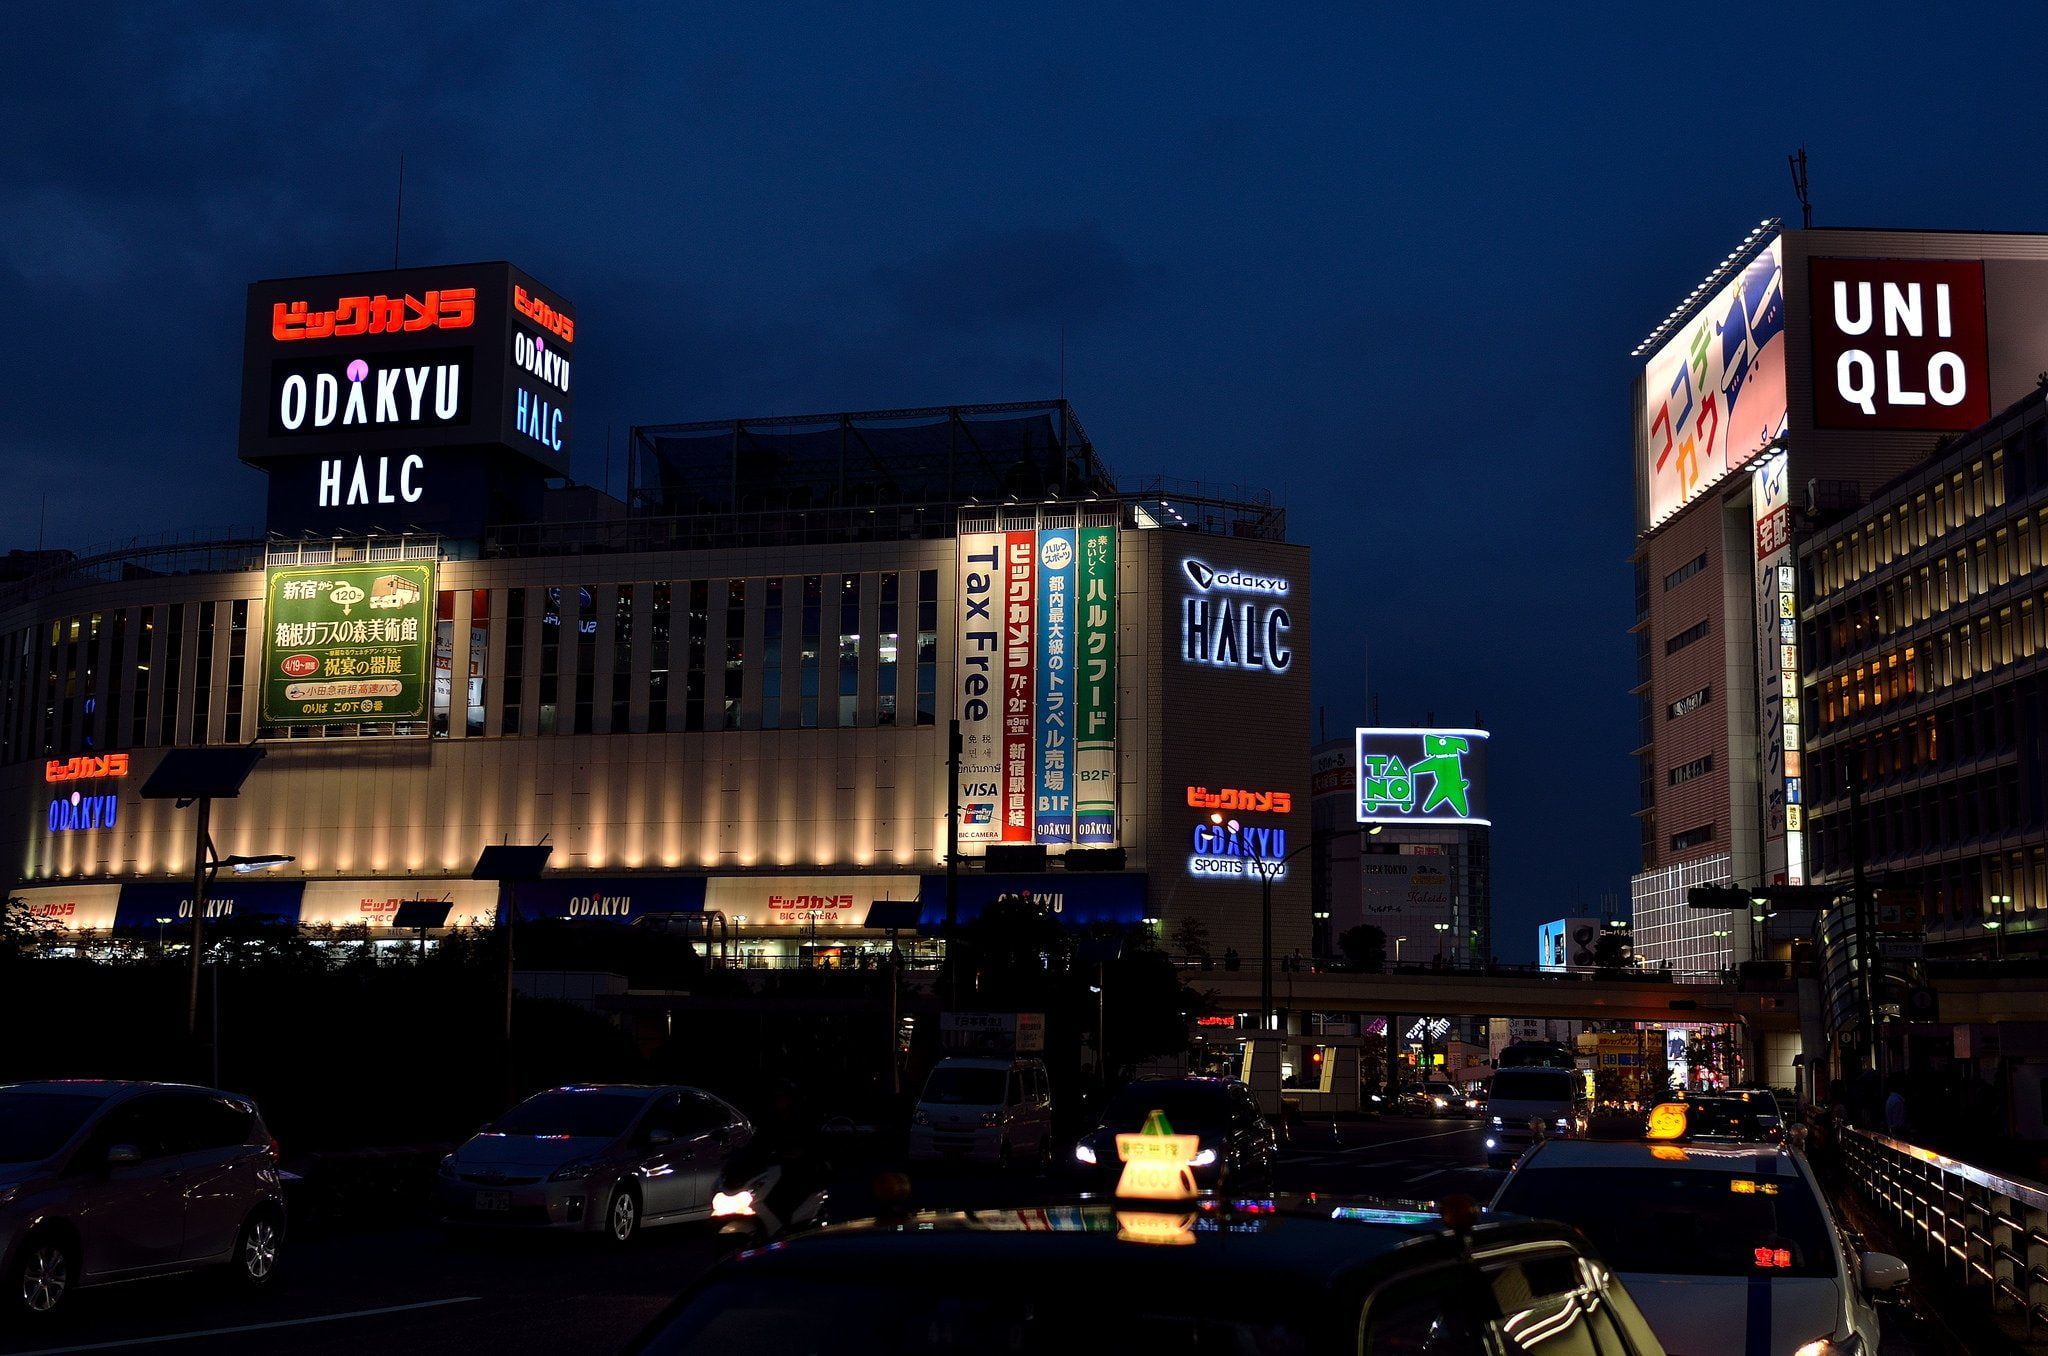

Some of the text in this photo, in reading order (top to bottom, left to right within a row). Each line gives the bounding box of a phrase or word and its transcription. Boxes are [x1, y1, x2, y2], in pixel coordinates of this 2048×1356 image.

[273, 288, 476, 341] ビックカメラ
[514, 285, 574, 343] ビックカメラ
[1833, 281, 1952, 337] UNI
[515, 332, 569, 392] ODAKYU
[281, 364, 459, 429] ODAKYU
[1837, 349, 1967, 415] QLO
[517, 387, 562, 451] HALC
[319, 455, 423, 506] HALC
[1760, 510, 1787, 552] 宅配
[1044, 551, 1071, 565] スポーツ
[1045, 542, 1068, 555] ハルク
[1086, 538, 1097, 576] おいしく
[1097, 535, 1109, 564] 楽しく
[283, 580, 333, 600] 新宿から
[1218, 573, 1288, 591] odakyu
[275, 617, 418, 647] 箱根ガラスの森美術館
[965, 545, 999, 721] Tax Free
[1008, 543, 1031, 713] ビックカメラ 7F 2F
[1187, 599, 1291, 670] HALC
[324, 655, 402, 677] 祝宴の器展
[1086, 579, 1108, 734] ハルクフード
[1762, 565, 1781, 775] クリーニング
[306, 683, 399, 697] 小田急箱根高速バス
[1038, 575, 1069, 811] 都内最大級のトラベル売場 B1F
[302, 703, 328, 714] のりば
[45, 753, 129, 782] ビックカメラ
[1080, 770, 1111, 782] B2F
[1365, 755, 1408, 777] TA
[961, 783, 998, 796] VISA
[1008, 742, 1026, 828] 新宿駅直結
[1187, 786, 1291, 813] ビックカメラ
[1365, 777, 1410, 800] NO
[49, 795, 117, 832] ODAKYU
[1079, 821, 1112, 835] ODAKYU
[1038, 822, 1071, 836] ODAKYU
[1194, 823, 1286, 859] ODAKYU
[1195, 858, 1286, 876] SPORTS FOOD
[29, 903, 76, 918] ビックカメラ
[569, 896, 631, 916] ODAKYU
[768, 895, 853, 909] ビックカメラ
[780, 912, 795, 920] BIC
[1755, 1247, 1791, 1268] 空車
